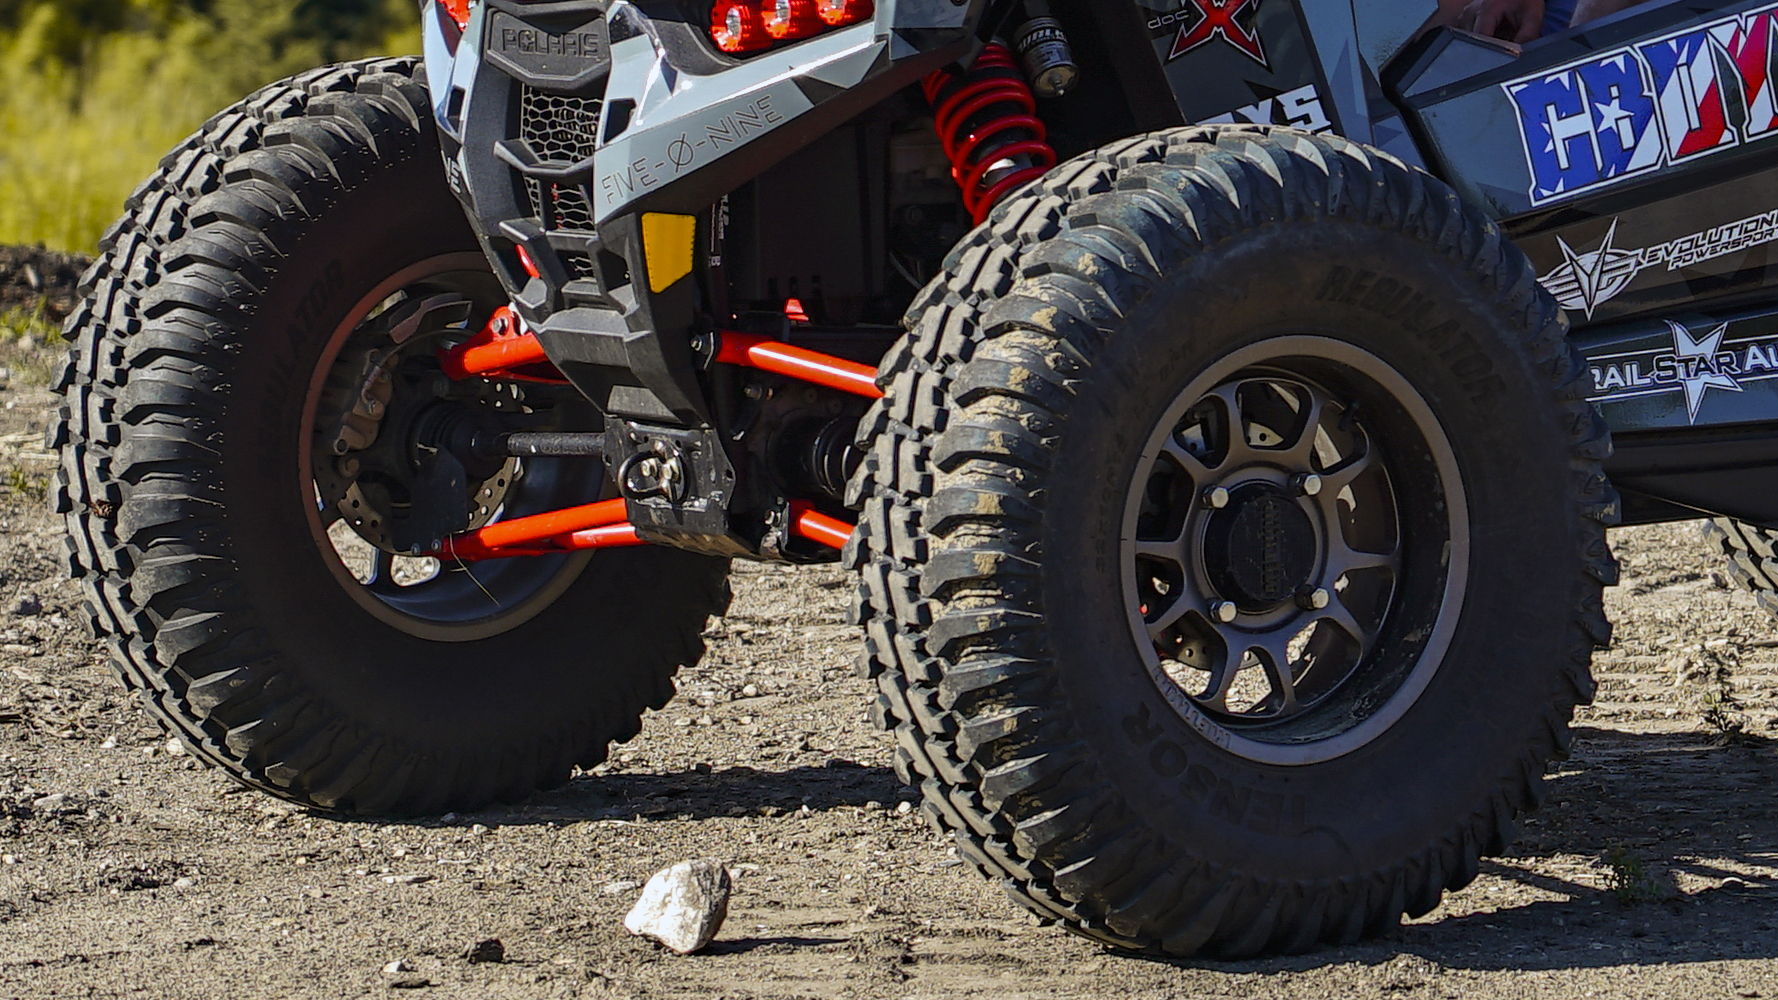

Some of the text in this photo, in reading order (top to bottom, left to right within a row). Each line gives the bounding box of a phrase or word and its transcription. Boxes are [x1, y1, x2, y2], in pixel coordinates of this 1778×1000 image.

[501, 28, 600, 60] POLARIS
[1646, 209, 1778, 265] EVOLUTION
[1653, 350, 1742, 384] STAR
